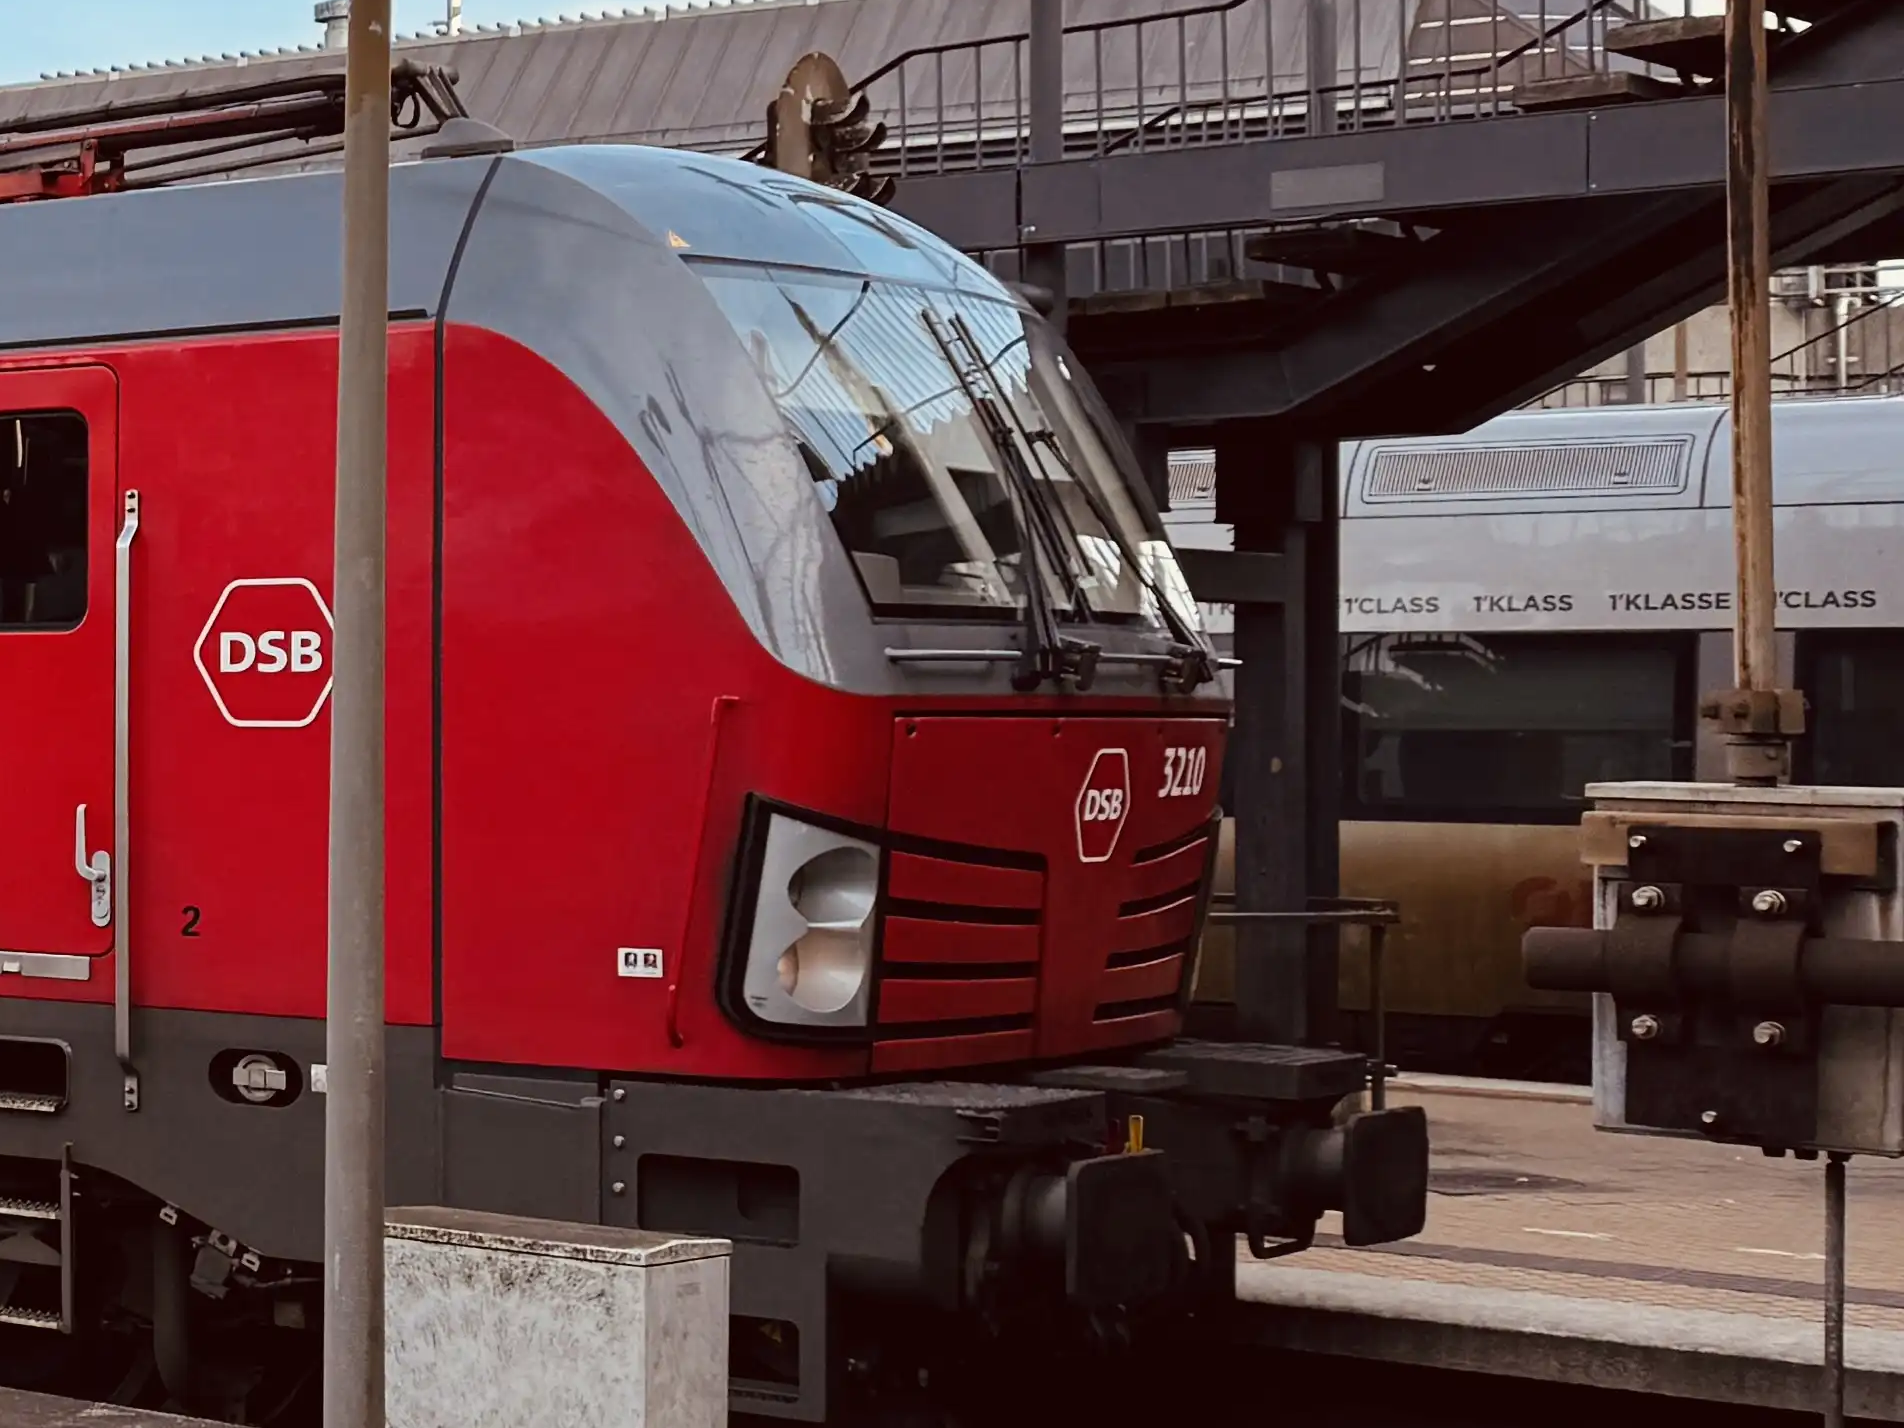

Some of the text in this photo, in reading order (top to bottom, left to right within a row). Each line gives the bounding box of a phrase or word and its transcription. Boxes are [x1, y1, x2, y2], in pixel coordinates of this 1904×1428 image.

[218, 629, 323, 673] DSB
[1158, 745, 1206, 798] 3210
[1082, 788, 1124, 821] DSB
[180, 905, 201, 938] 2
